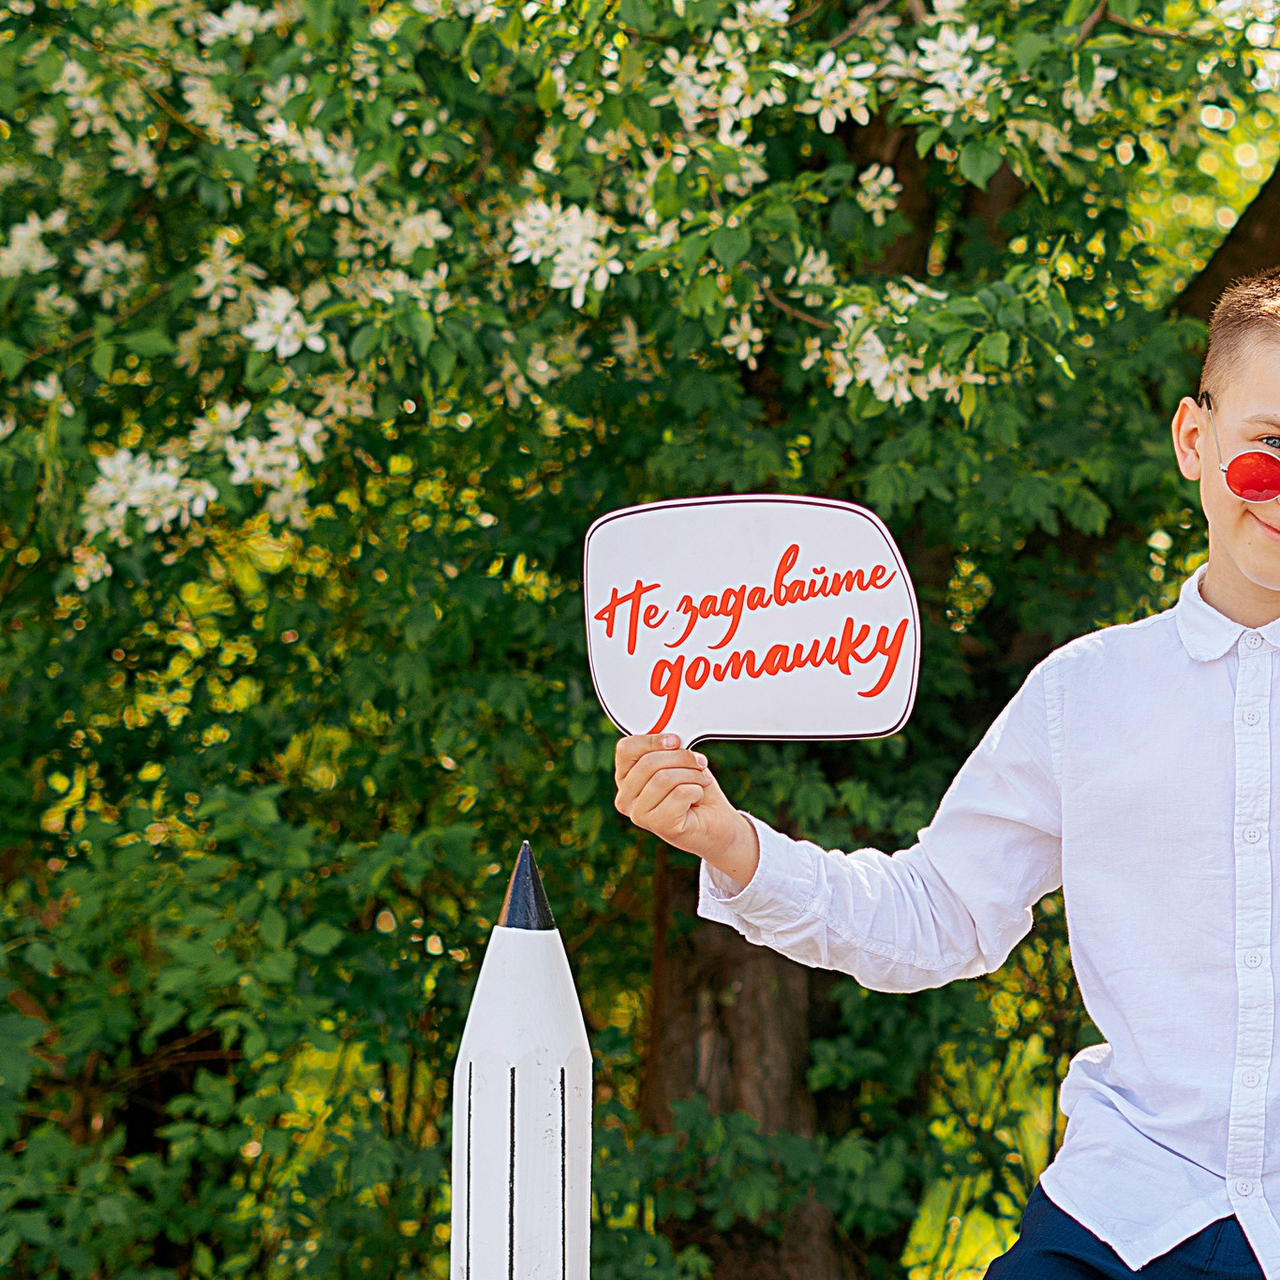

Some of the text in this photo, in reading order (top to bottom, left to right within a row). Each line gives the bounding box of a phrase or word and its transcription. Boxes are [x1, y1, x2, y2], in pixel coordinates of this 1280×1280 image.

[594, 544, 897, 655] Не задавайте
[646, 617, 909, 735] домашку
